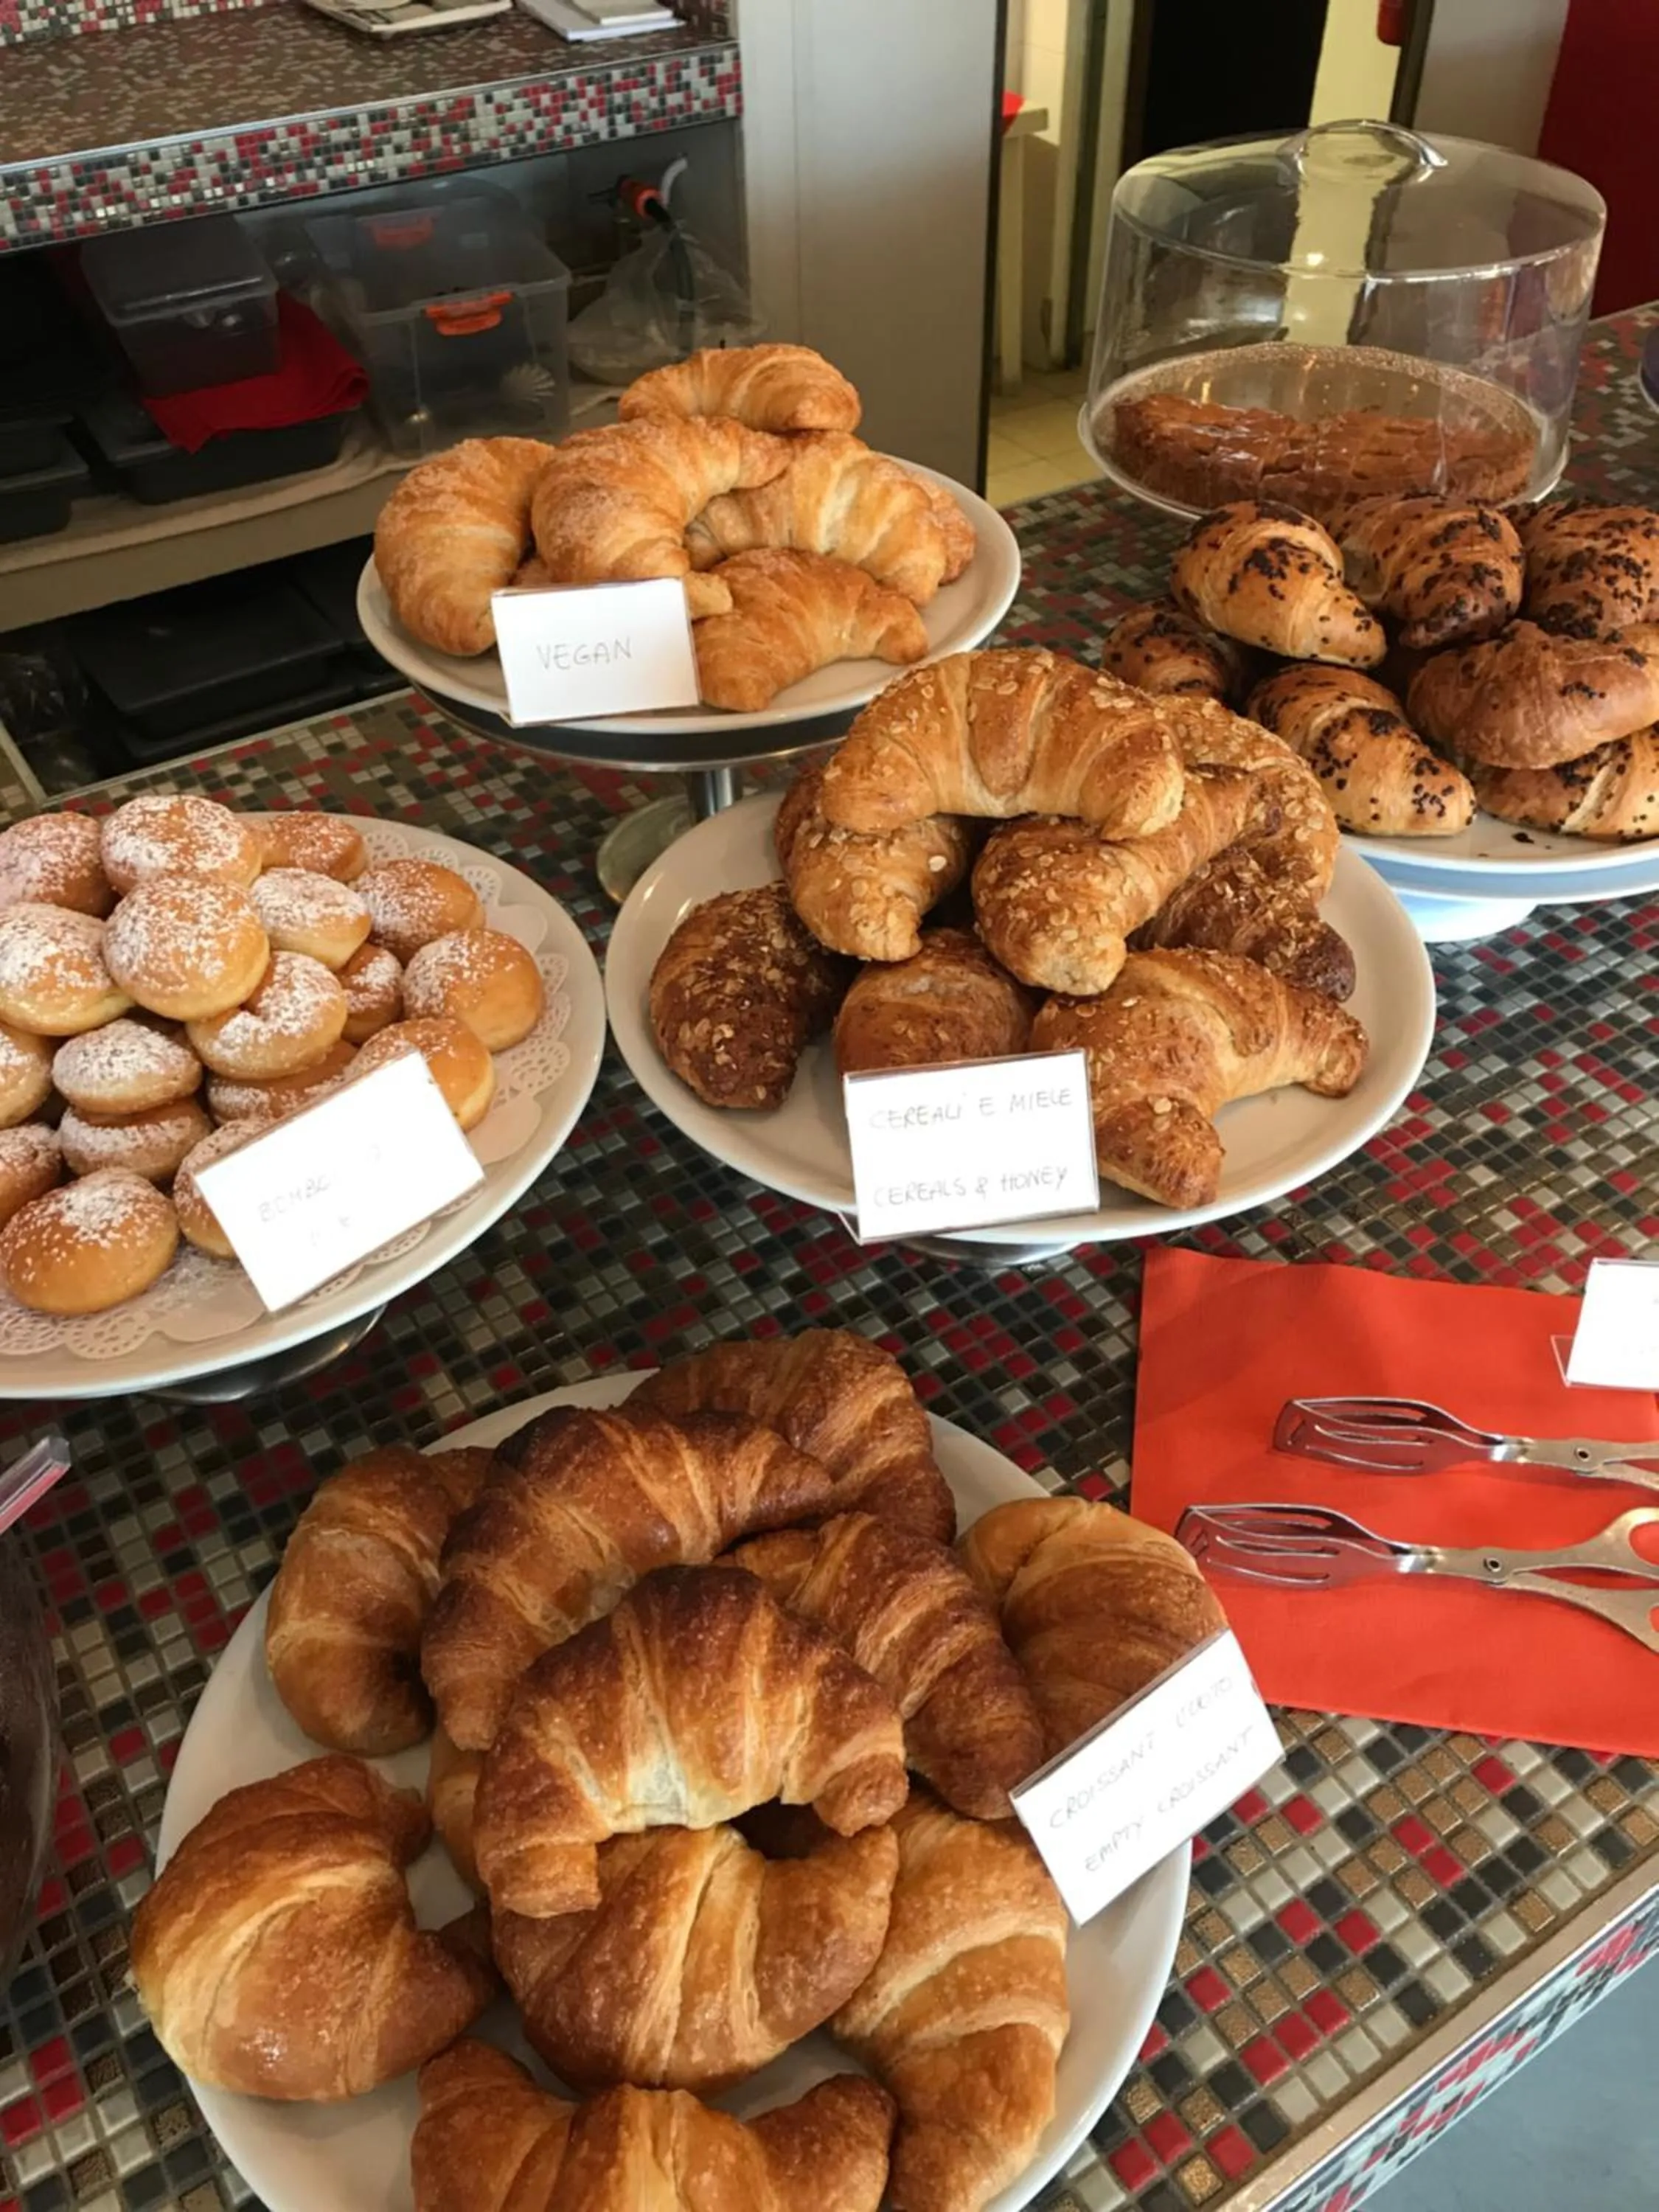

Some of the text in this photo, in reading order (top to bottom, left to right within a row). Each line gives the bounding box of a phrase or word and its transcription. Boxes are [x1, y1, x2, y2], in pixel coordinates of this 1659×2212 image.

[535, 635, 633, 671] VEGAN
[978, 1096, 996, 1116] E
[1009, 1087, 1073, 1113] MIELE
[873, 1176, 967, 1208] CEREALS
[1000, 1165, 1068, 1192] HONEY
